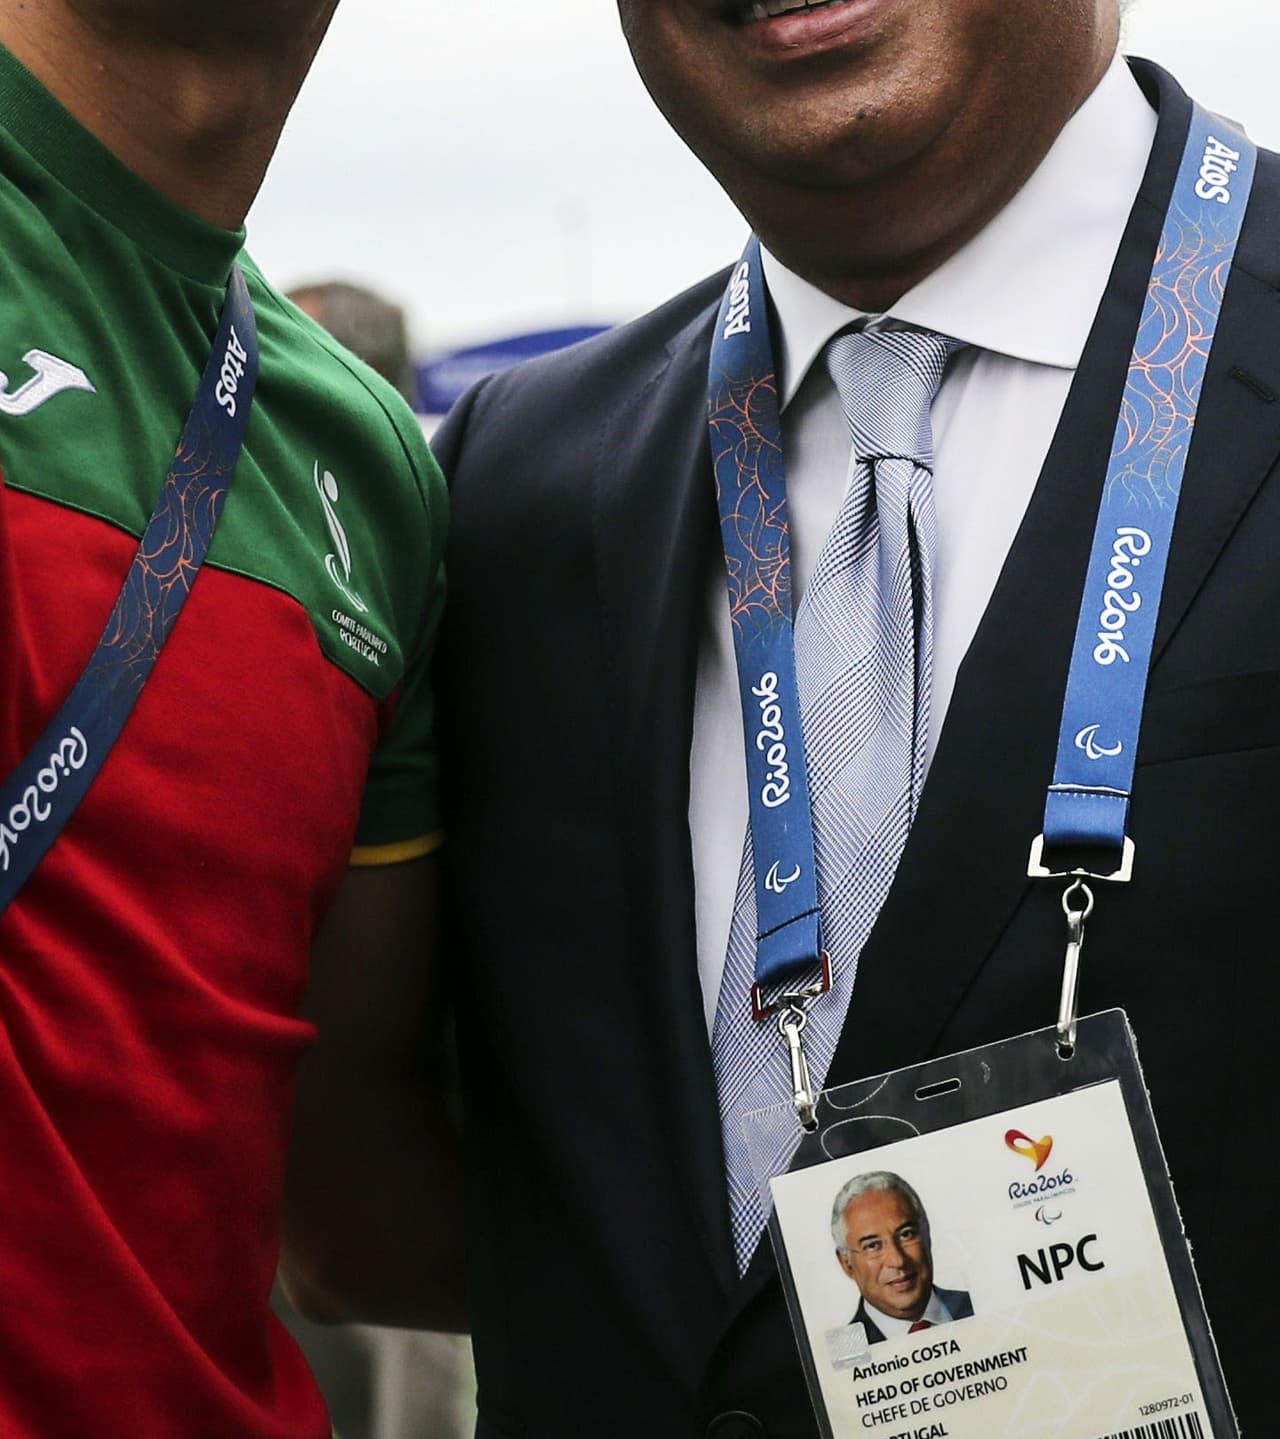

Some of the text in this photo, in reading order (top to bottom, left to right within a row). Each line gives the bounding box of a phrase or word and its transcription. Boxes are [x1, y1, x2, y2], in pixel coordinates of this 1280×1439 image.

[1195, 136, 1240, 204] Atos
[724, 262, 751, 340] Atos
[216, 325, 247, 417] Atos
[1093, 527, 1152, 666] Rio2016
[752, 672, 790, 808] Rio2016
[1008, 1168, 1074, 1200] Rio2016
[1017, 1233, 1105, 1290] NPC
[853, 1339, 961, 1381] Antonio COSTA
[856, 1347, 1029, 1408] HEAD OF GOVERNMENT
[862, 1376, 1008, 1428] CHEFE DE GOVERNO
[1138, 1393, 1194, 1416] 1280972-01
